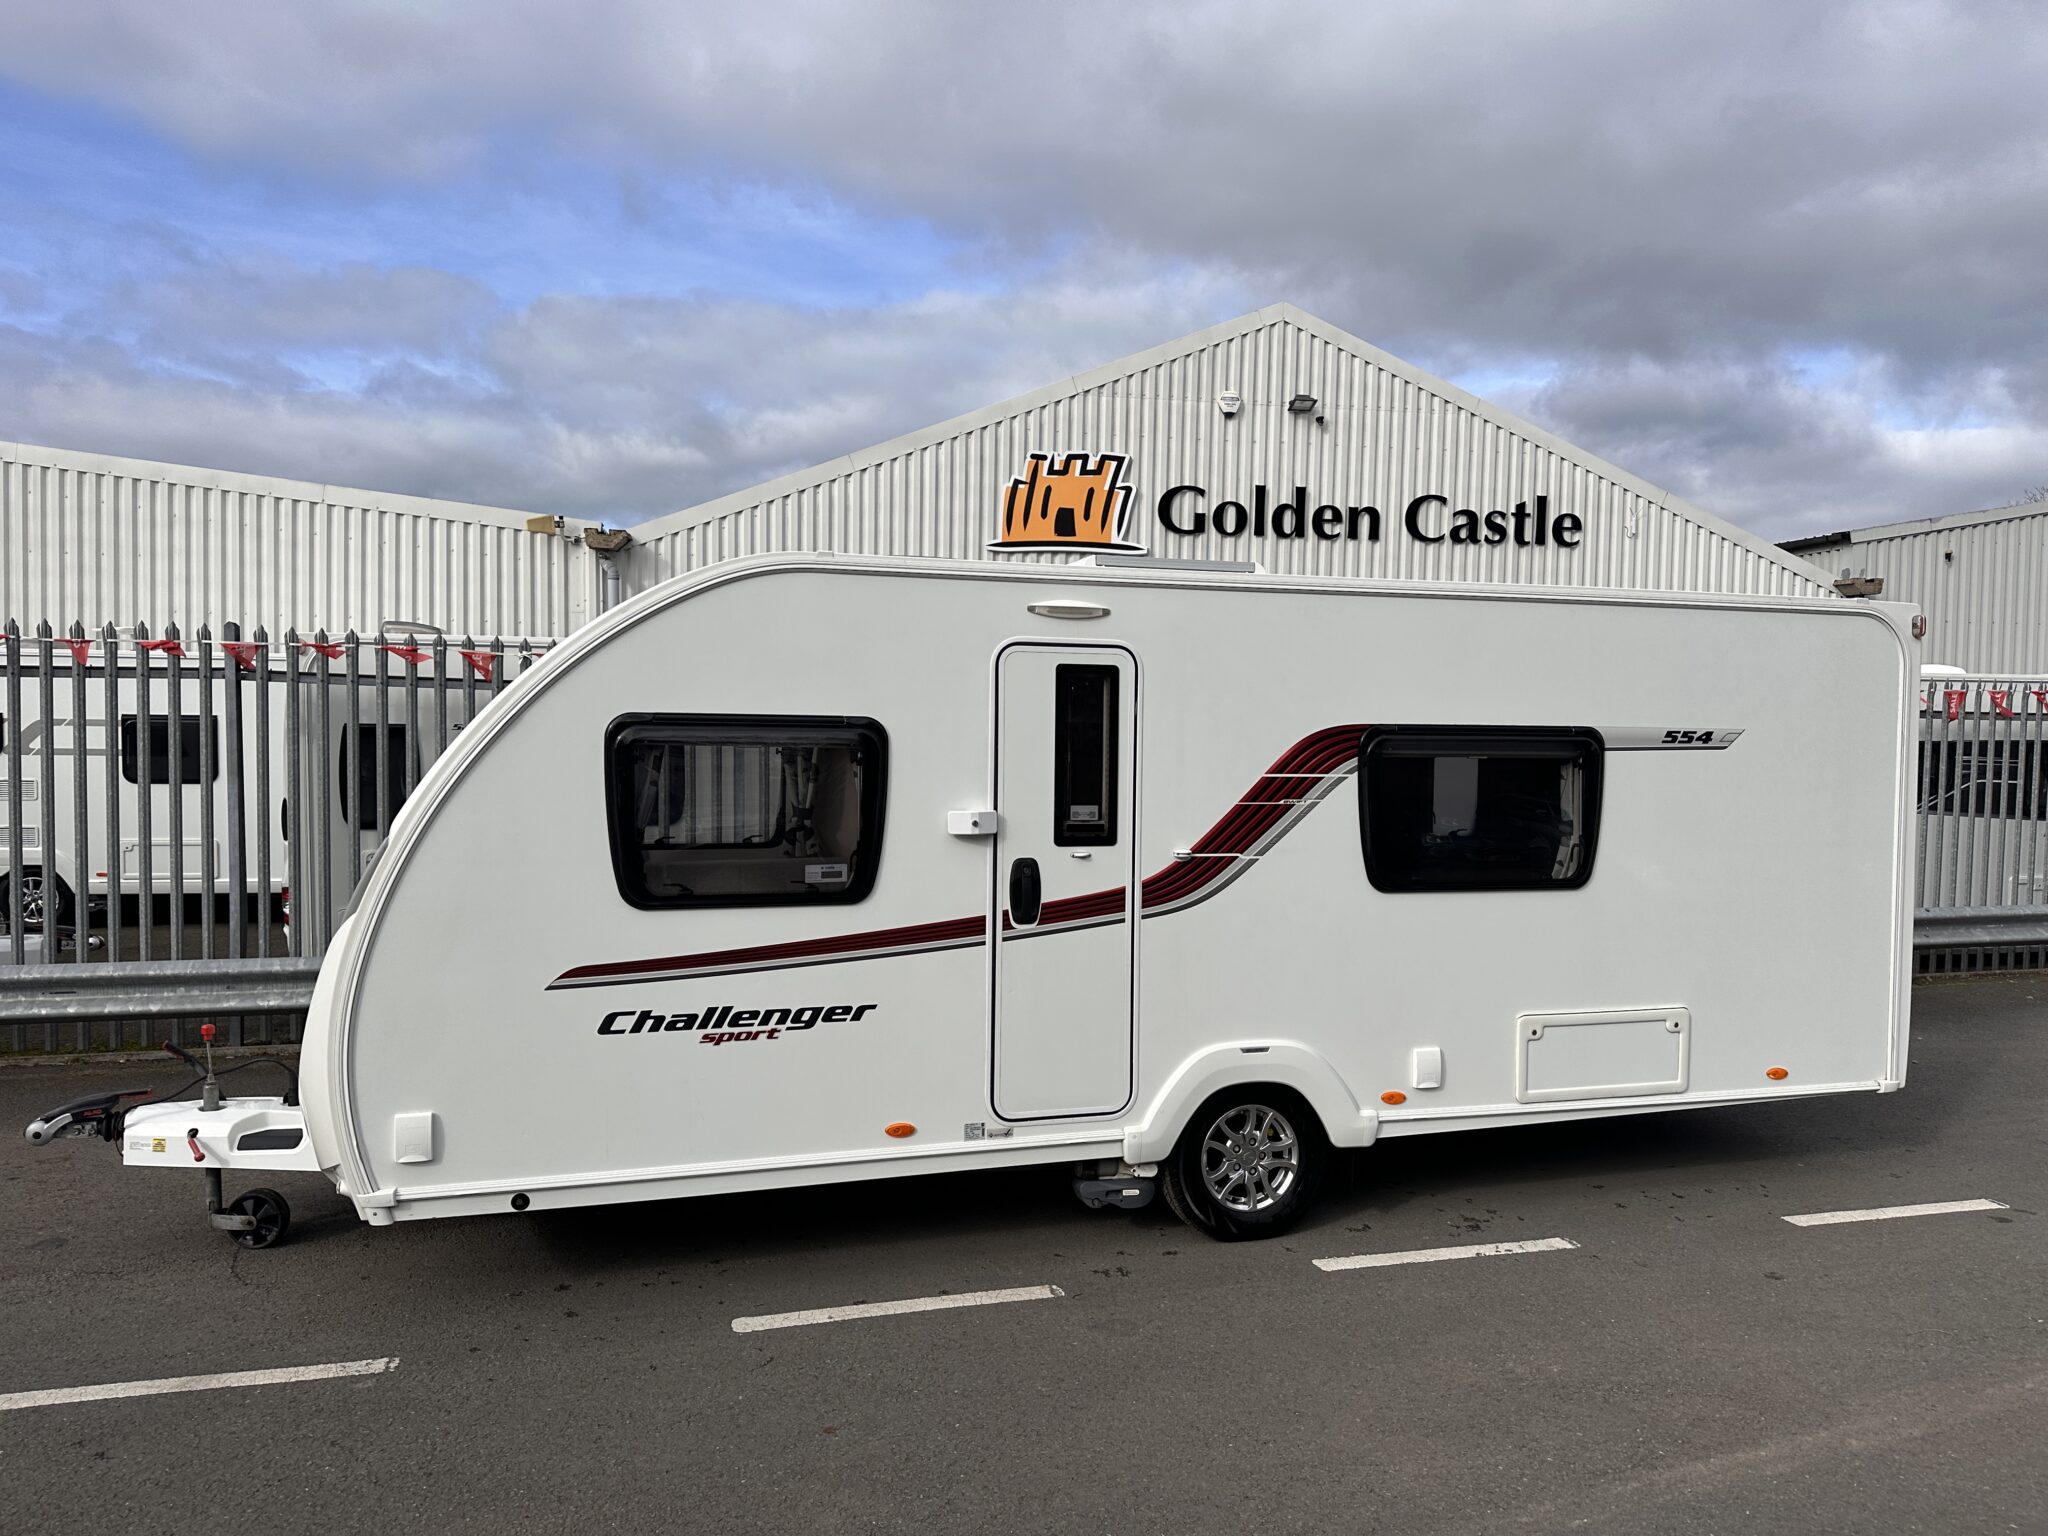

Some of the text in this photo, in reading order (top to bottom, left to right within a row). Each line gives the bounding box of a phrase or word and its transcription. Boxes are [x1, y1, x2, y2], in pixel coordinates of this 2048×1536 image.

[1157, 485, 1583, 548] Golden Castle
[1661, 730, 1715, 744] 554
[597, 1004, 878, 1035] Challenger
[699, 1027, 782, 1046] sport
